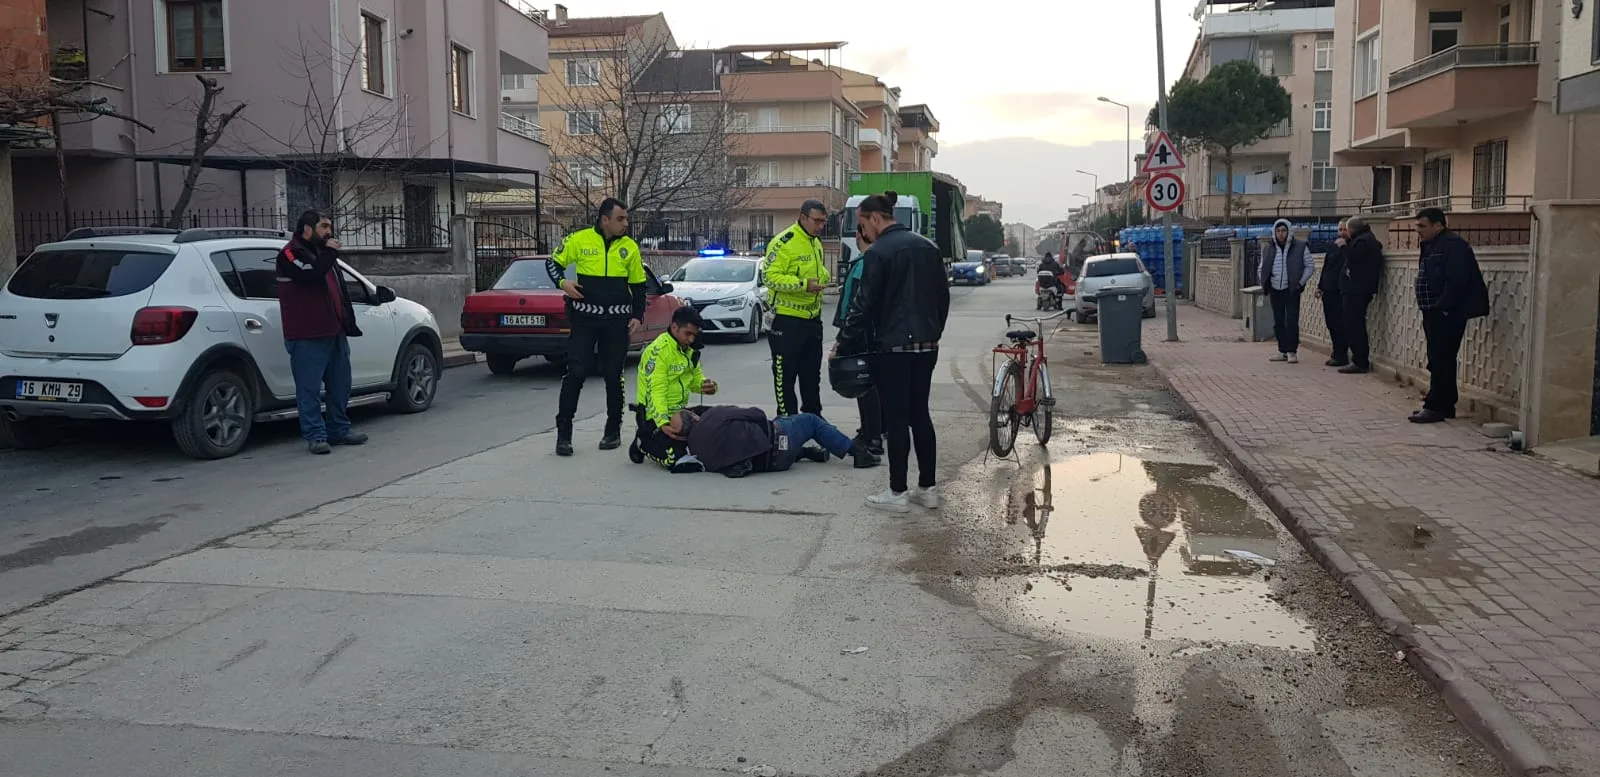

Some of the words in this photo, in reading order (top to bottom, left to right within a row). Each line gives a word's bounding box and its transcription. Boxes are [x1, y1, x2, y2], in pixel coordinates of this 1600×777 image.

[1153, 182, 1178, 202] 30
[505, 315, 515, 325] 16
[515, 315, 529, 325] ACT
[530, 315, 545, 326] 518
[23, 382, 35, 395] 16
[41, 383, 61, 396] KMH
[67, 384, 81, 398] 29
